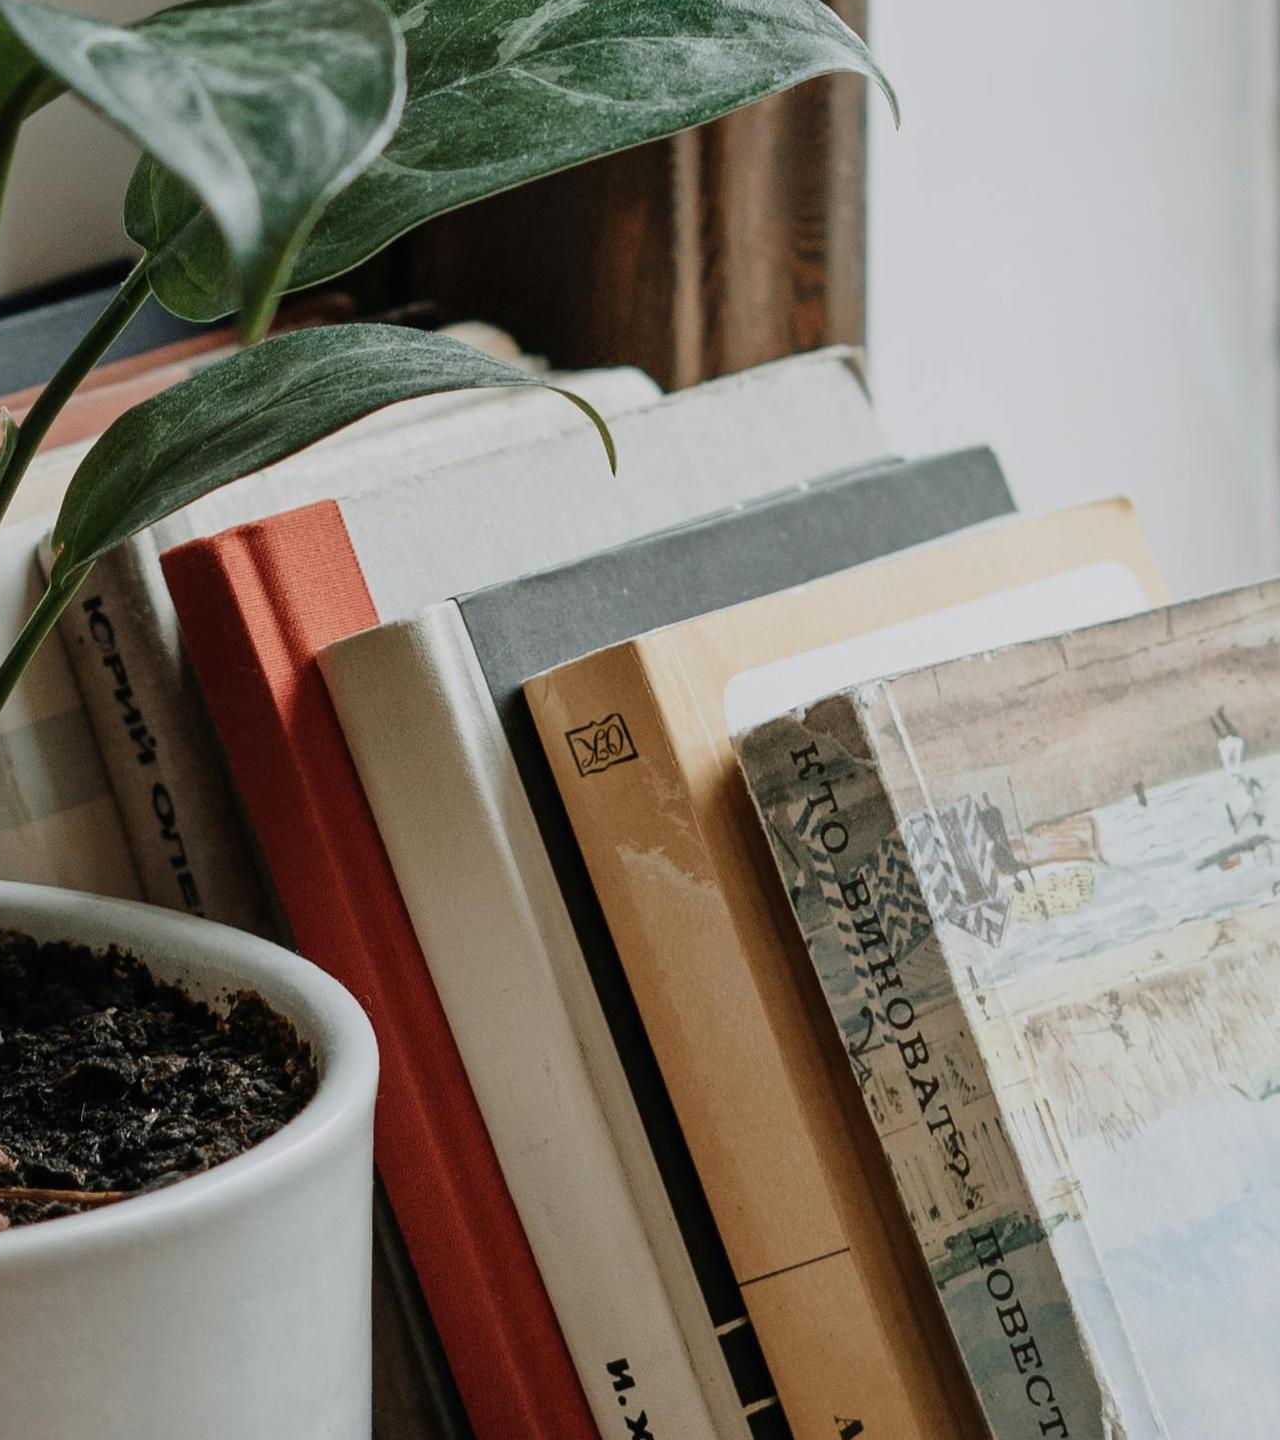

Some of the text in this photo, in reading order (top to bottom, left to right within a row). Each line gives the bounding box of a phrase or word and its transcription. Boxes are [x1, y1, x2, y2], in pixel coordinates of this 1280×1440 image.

[83, 595, 205, 919] ЮРИЙ ОЛЕ
[790, 740, 850, 855] КТО
